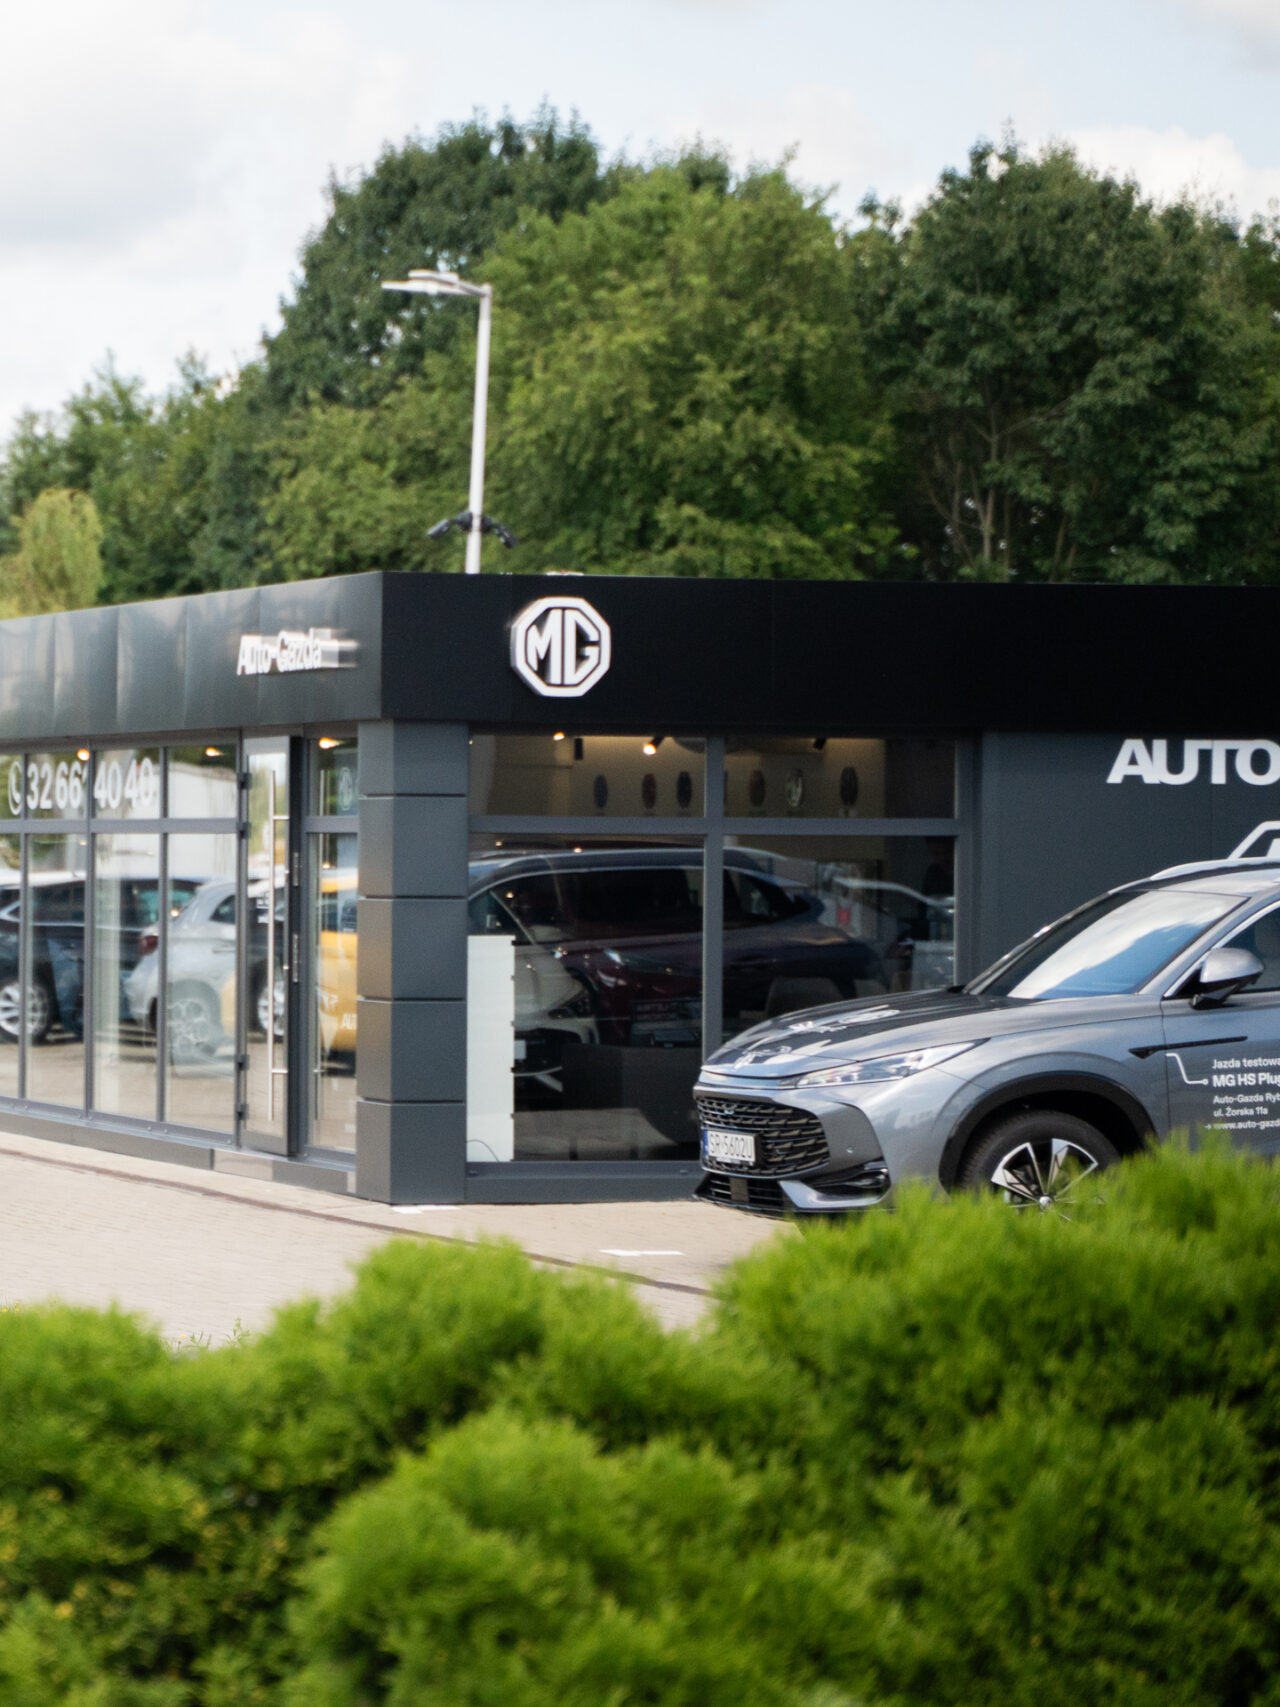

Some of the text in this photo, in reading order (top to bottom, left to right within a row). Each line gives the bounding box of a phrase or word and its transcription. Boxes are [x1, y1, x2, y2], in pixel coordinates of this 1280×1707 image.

[523, 604, 604, 689] MG
[1106, 738, 1280, 786] AUTO
[1212, 1058, 1241, 1069] Jazda
[1212, 1074, 1236, 1088] MG
[1237, 1073, 1257, 1087] HS
[1213, 1093, 1264, 1105] Auto-Gazda
